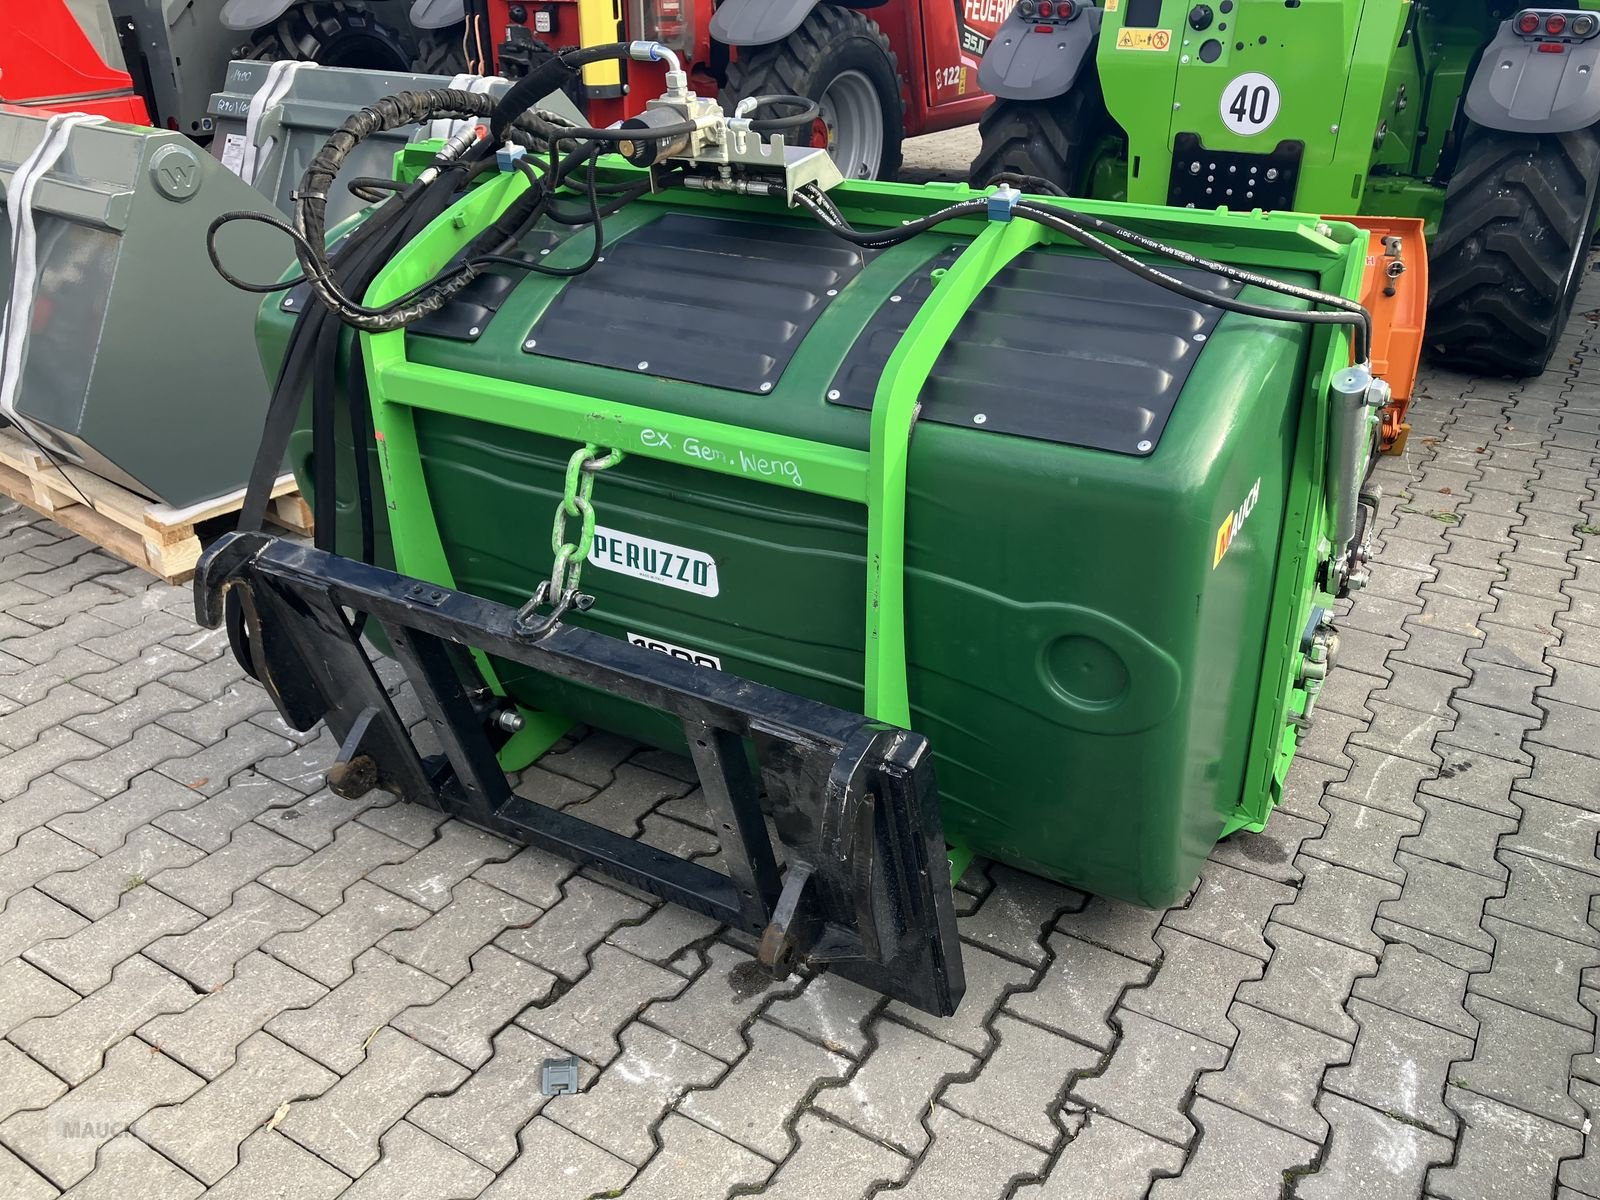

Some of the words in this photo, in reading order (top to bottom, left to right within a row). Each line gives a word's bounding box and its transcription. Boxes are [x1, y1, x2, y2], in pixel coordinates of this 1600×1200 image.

[942, 65, 960, 86] 122
[1229, 85, 1270, 124] 40
[739, 450, 803, 487] Weng
[1217, 476, 1261, 562] MAUCH
[594, 534, 709, 588] PERUZZO
